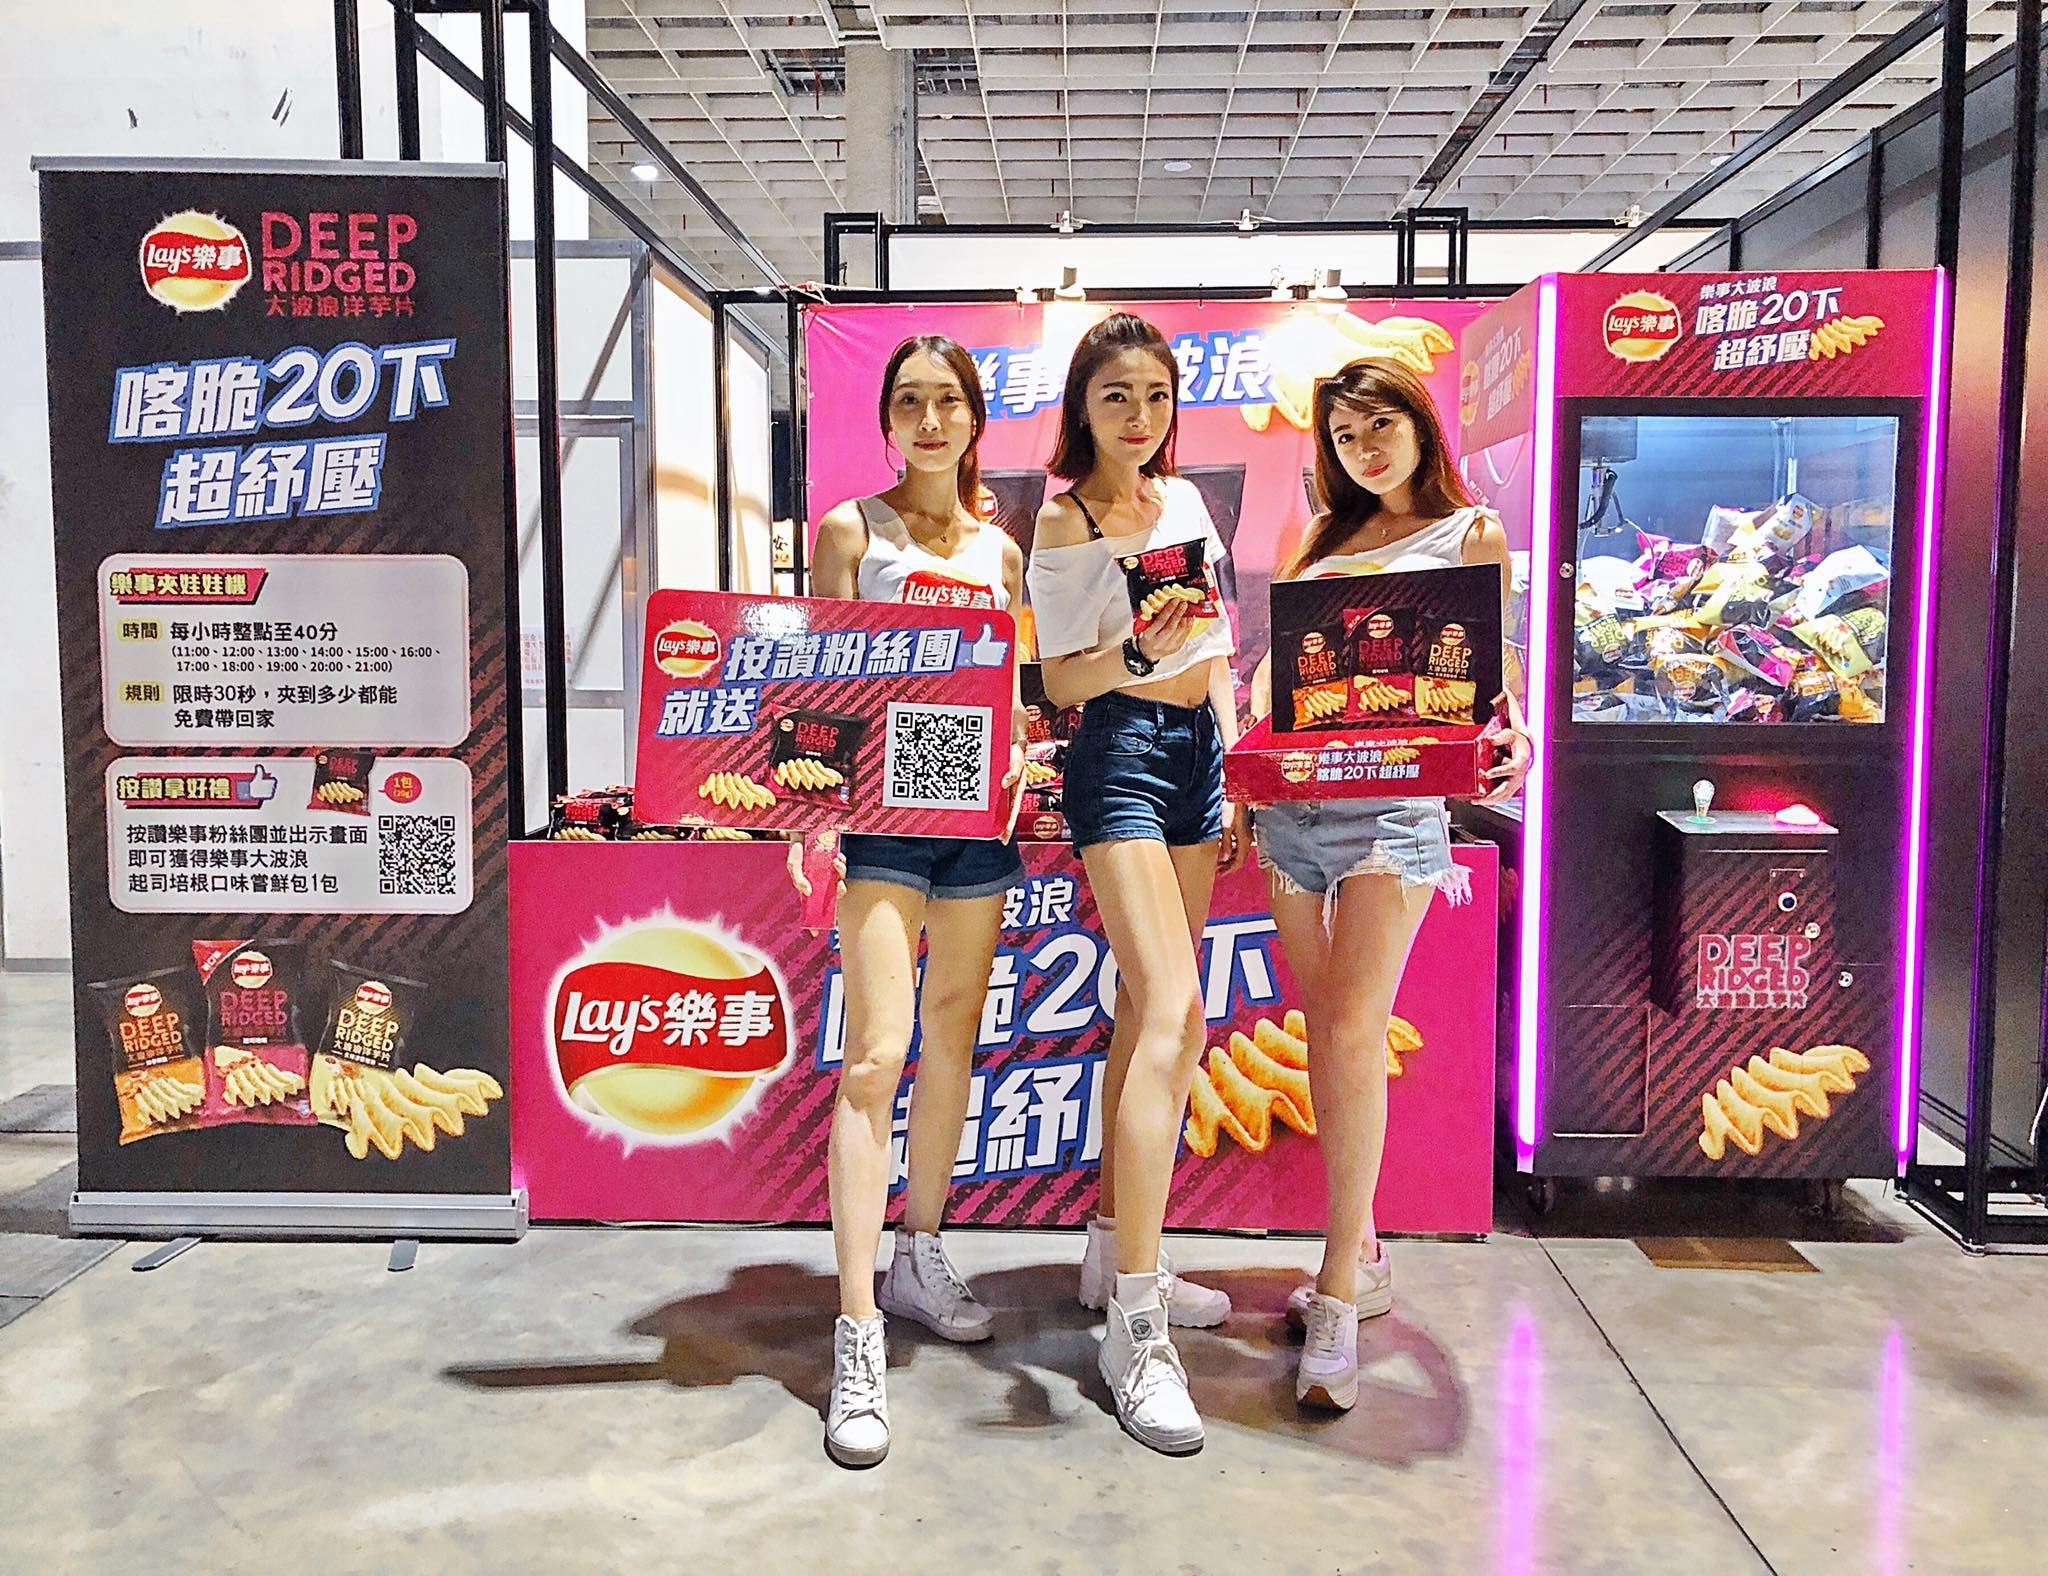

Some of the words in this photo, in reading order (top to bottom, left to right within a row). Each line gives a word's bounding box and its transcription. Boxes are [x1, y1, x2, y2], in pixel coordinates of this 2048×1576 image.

[260, 210, 418, 261] DEEP
[263, 260, 417, 294] RIDGED
[1700, 276, 1777, 300] 樂事大波浪
[111, 342, 454, 441] 喀脆20下
[160, 438, 384, 525] 超紓壓
[1140, 545, 1186, 568] DEEP
[110, 572, 248, 597] 樂事夾娃娃機
[122, 622, 158, 640] 時間
[170, 622, 338, 642] 每小時整點至40分
[724, 630, 958, 682] 按讚粉絲團
[1358, 638, 1404, 652] DEEP
[1430, 644, 1473, 660] DEEP
[1297, 650, 1336, 668] DEEP
[1299, 662, 1337, 676] RIDGED
[1428, 656, 1470, 669] RIDGED
[125, 685, 160, 702] 規則
[174, 708, 275, 730] 免費帶回家
[657, 688, 757, 736] 就送
[797, 721, 840, 738] DEEP
[117, 775, 233, 800] 按讚拿好禮
[393, 776, 414, 790] 1包
[126, 823, 369, 845] 按讚樂事粉絲團並出示畫面
[127, 848, 309, 869] 即可獲得樂事大波浪
[1698, 934, 1811, 969] DEEP
[1698, 966, 1809, 992] RIDGED
[220, 990, 289, 1011] DEEP
[119, 1012, 180, 1039] DEEP
[220, 1010, 288, 1026] RIDGED
[338, 1009, 399, 1040] DEEP
[123, 1030, 183, 1053] RIDGED
[335, 1026, 394, 1053] RIDGED
